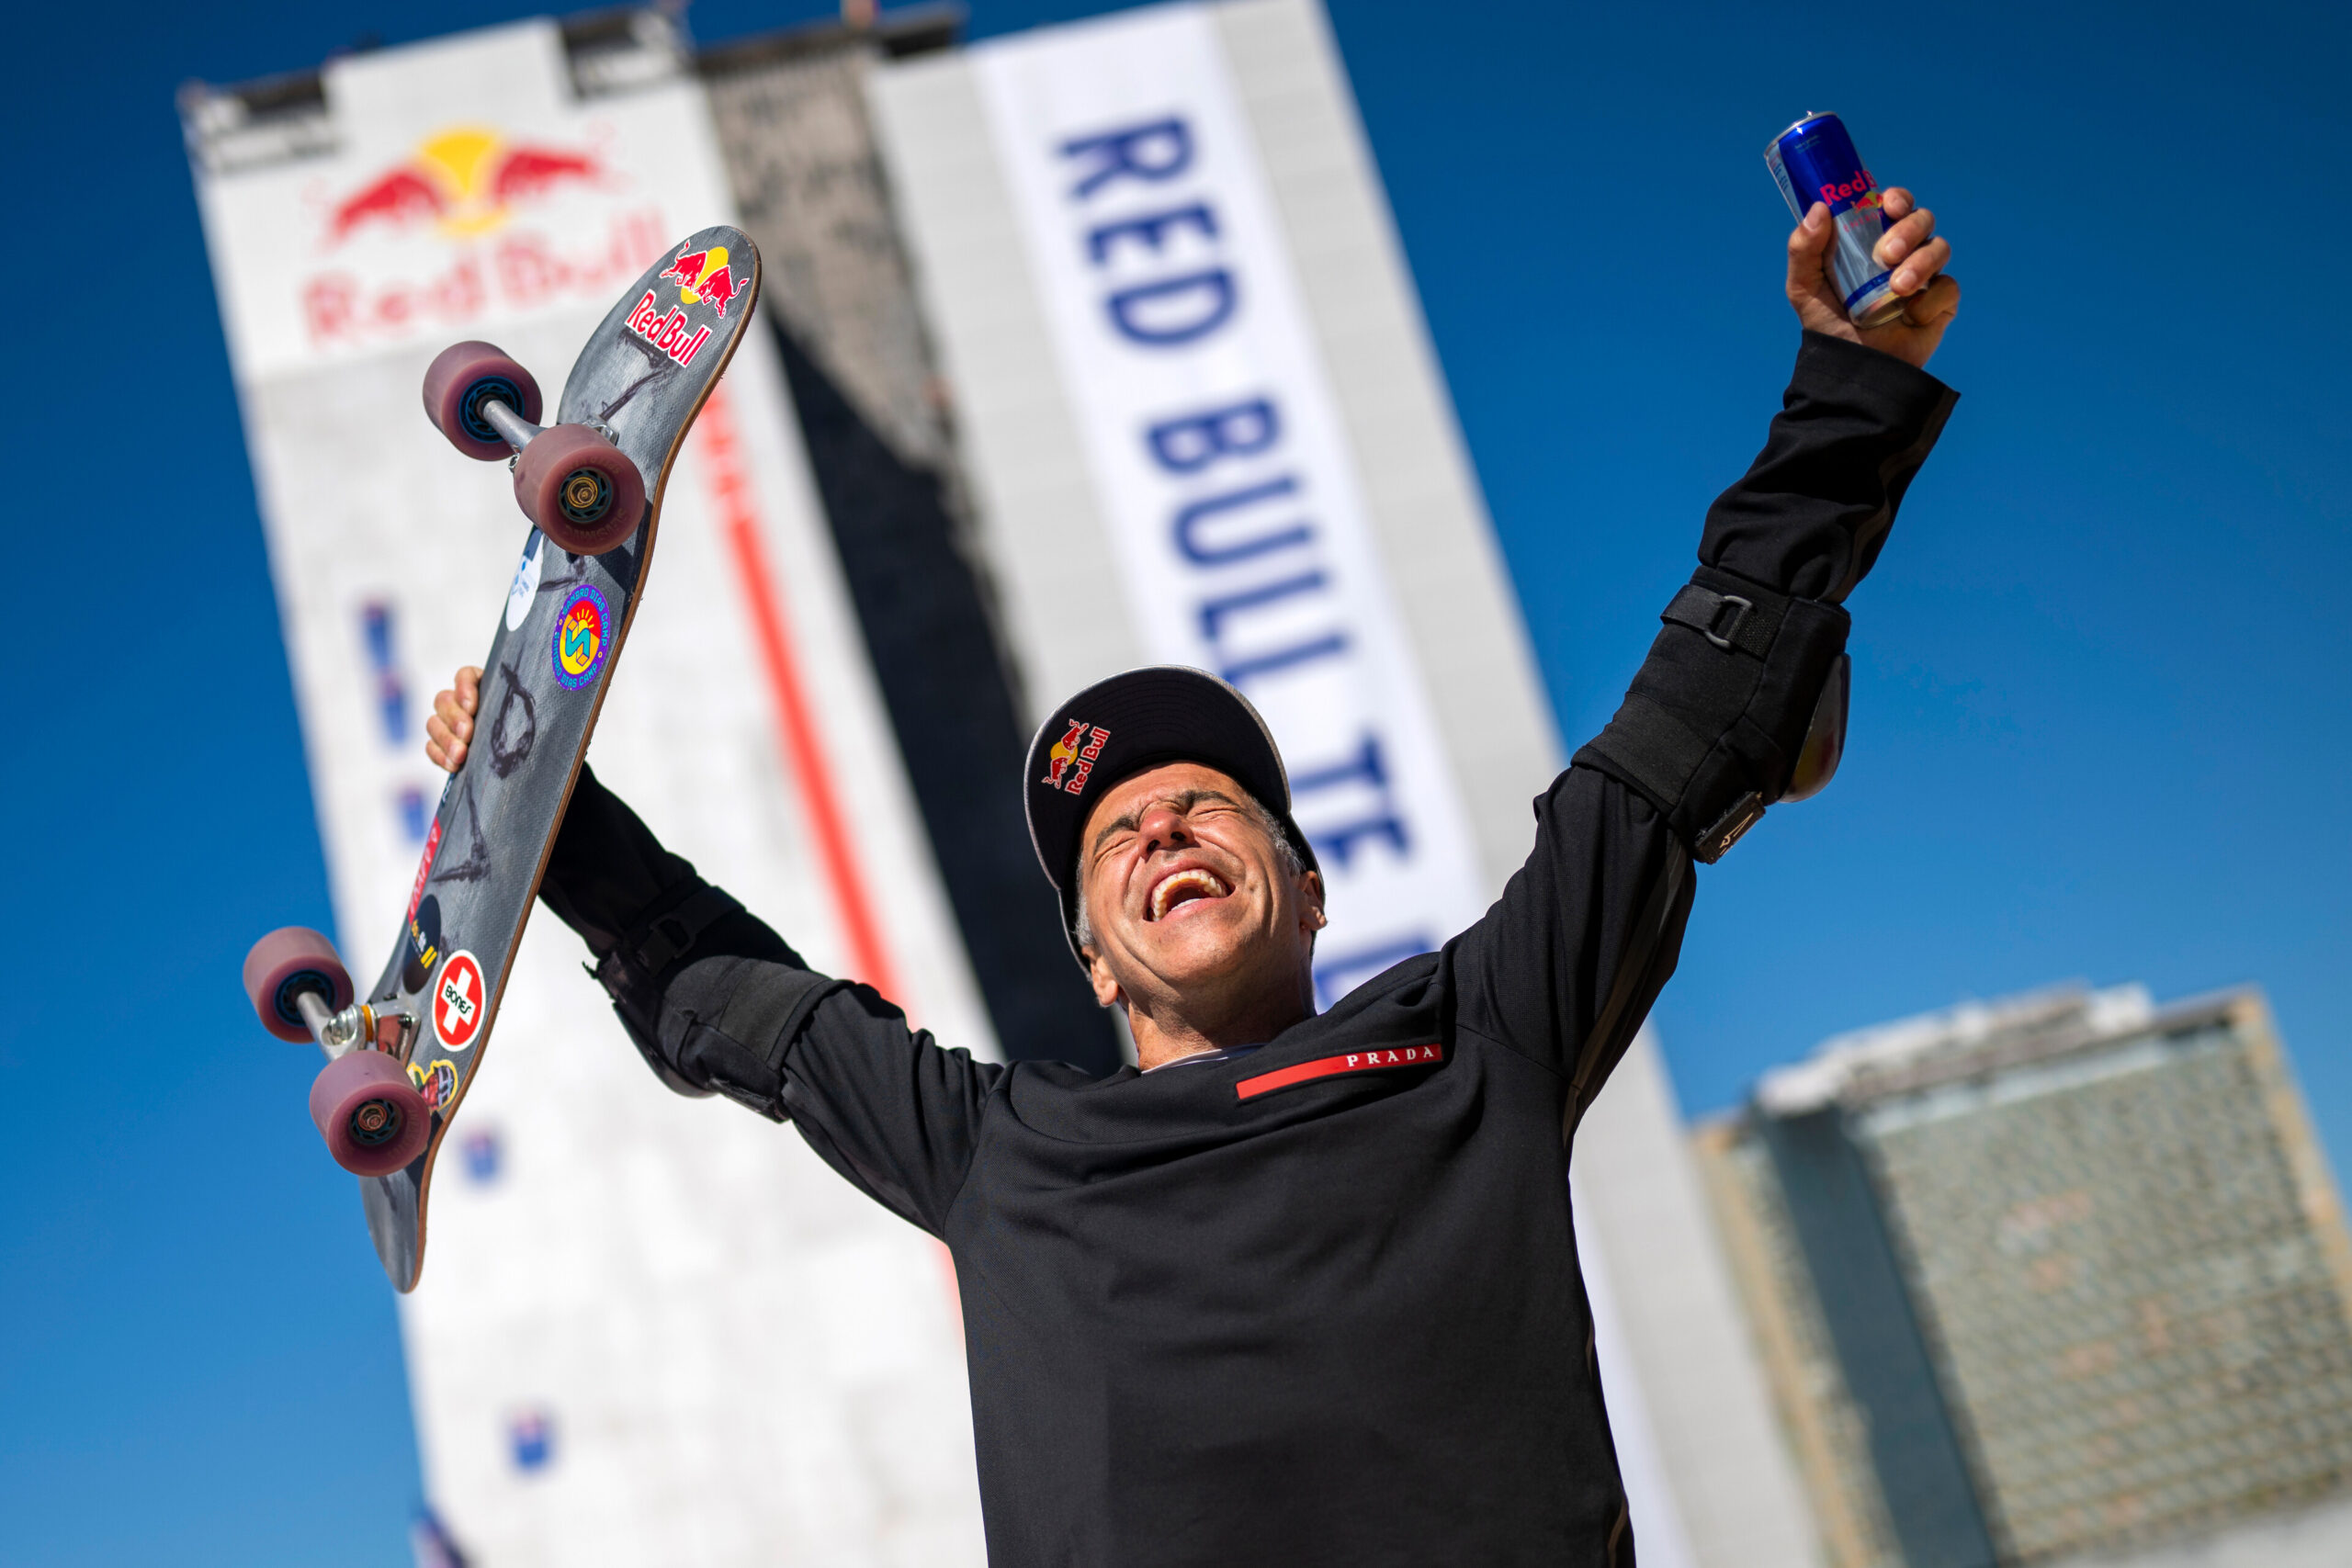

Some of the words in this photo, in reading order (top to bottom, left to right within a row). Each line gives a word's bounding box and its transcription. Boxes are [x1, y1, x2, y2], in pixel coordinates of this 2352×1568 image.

[1819, 171, 1867, 206] Red
[1054, 111, 1241, 353] RED
[301, 246, 487, 347] Red
[496, 207, 672, 306] Bull
[626, 291, 678, 343] Red
[656, 312, 711, 366] Bull
[1141, 392, 1352, 684] BULL
[589, 589, 605, 612] DIAS
[601, 613, 609, 647] CAMP
[560, 674, 578, 688] DIAS
[579, 662, 597, 686] CAMP
[1066, 759, 1093, 795] Red
[1081, 727, 1111, 761] Bull
[446, 985, 472, 1015] BONES
[1346, 1046, 1434, 1067] PRADA
